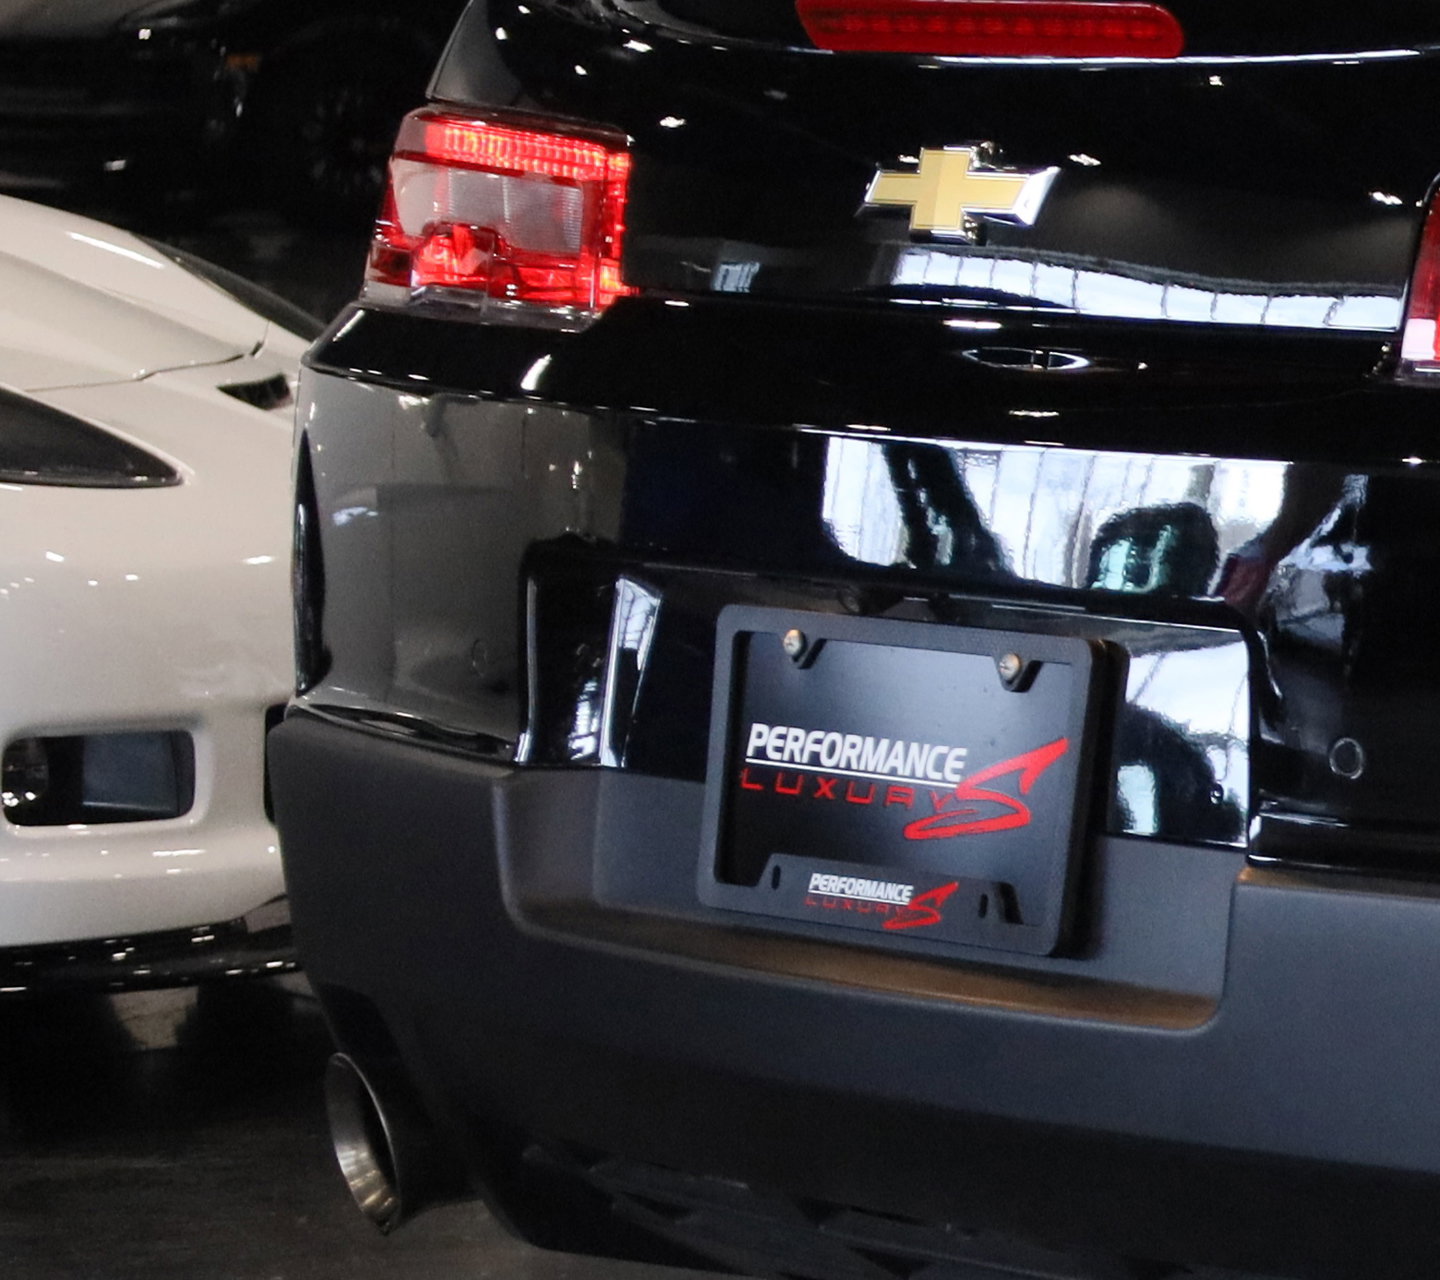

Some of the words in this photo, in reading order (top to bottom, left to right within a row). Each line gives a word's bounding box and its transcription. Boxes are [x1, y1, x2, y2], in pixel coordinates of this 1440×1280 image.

[747, 723, 967, 781] PERFORMANCE
[741, 768, 954, 810] LUXURY
[808, 872, 914, 902] PERFORMANCE
